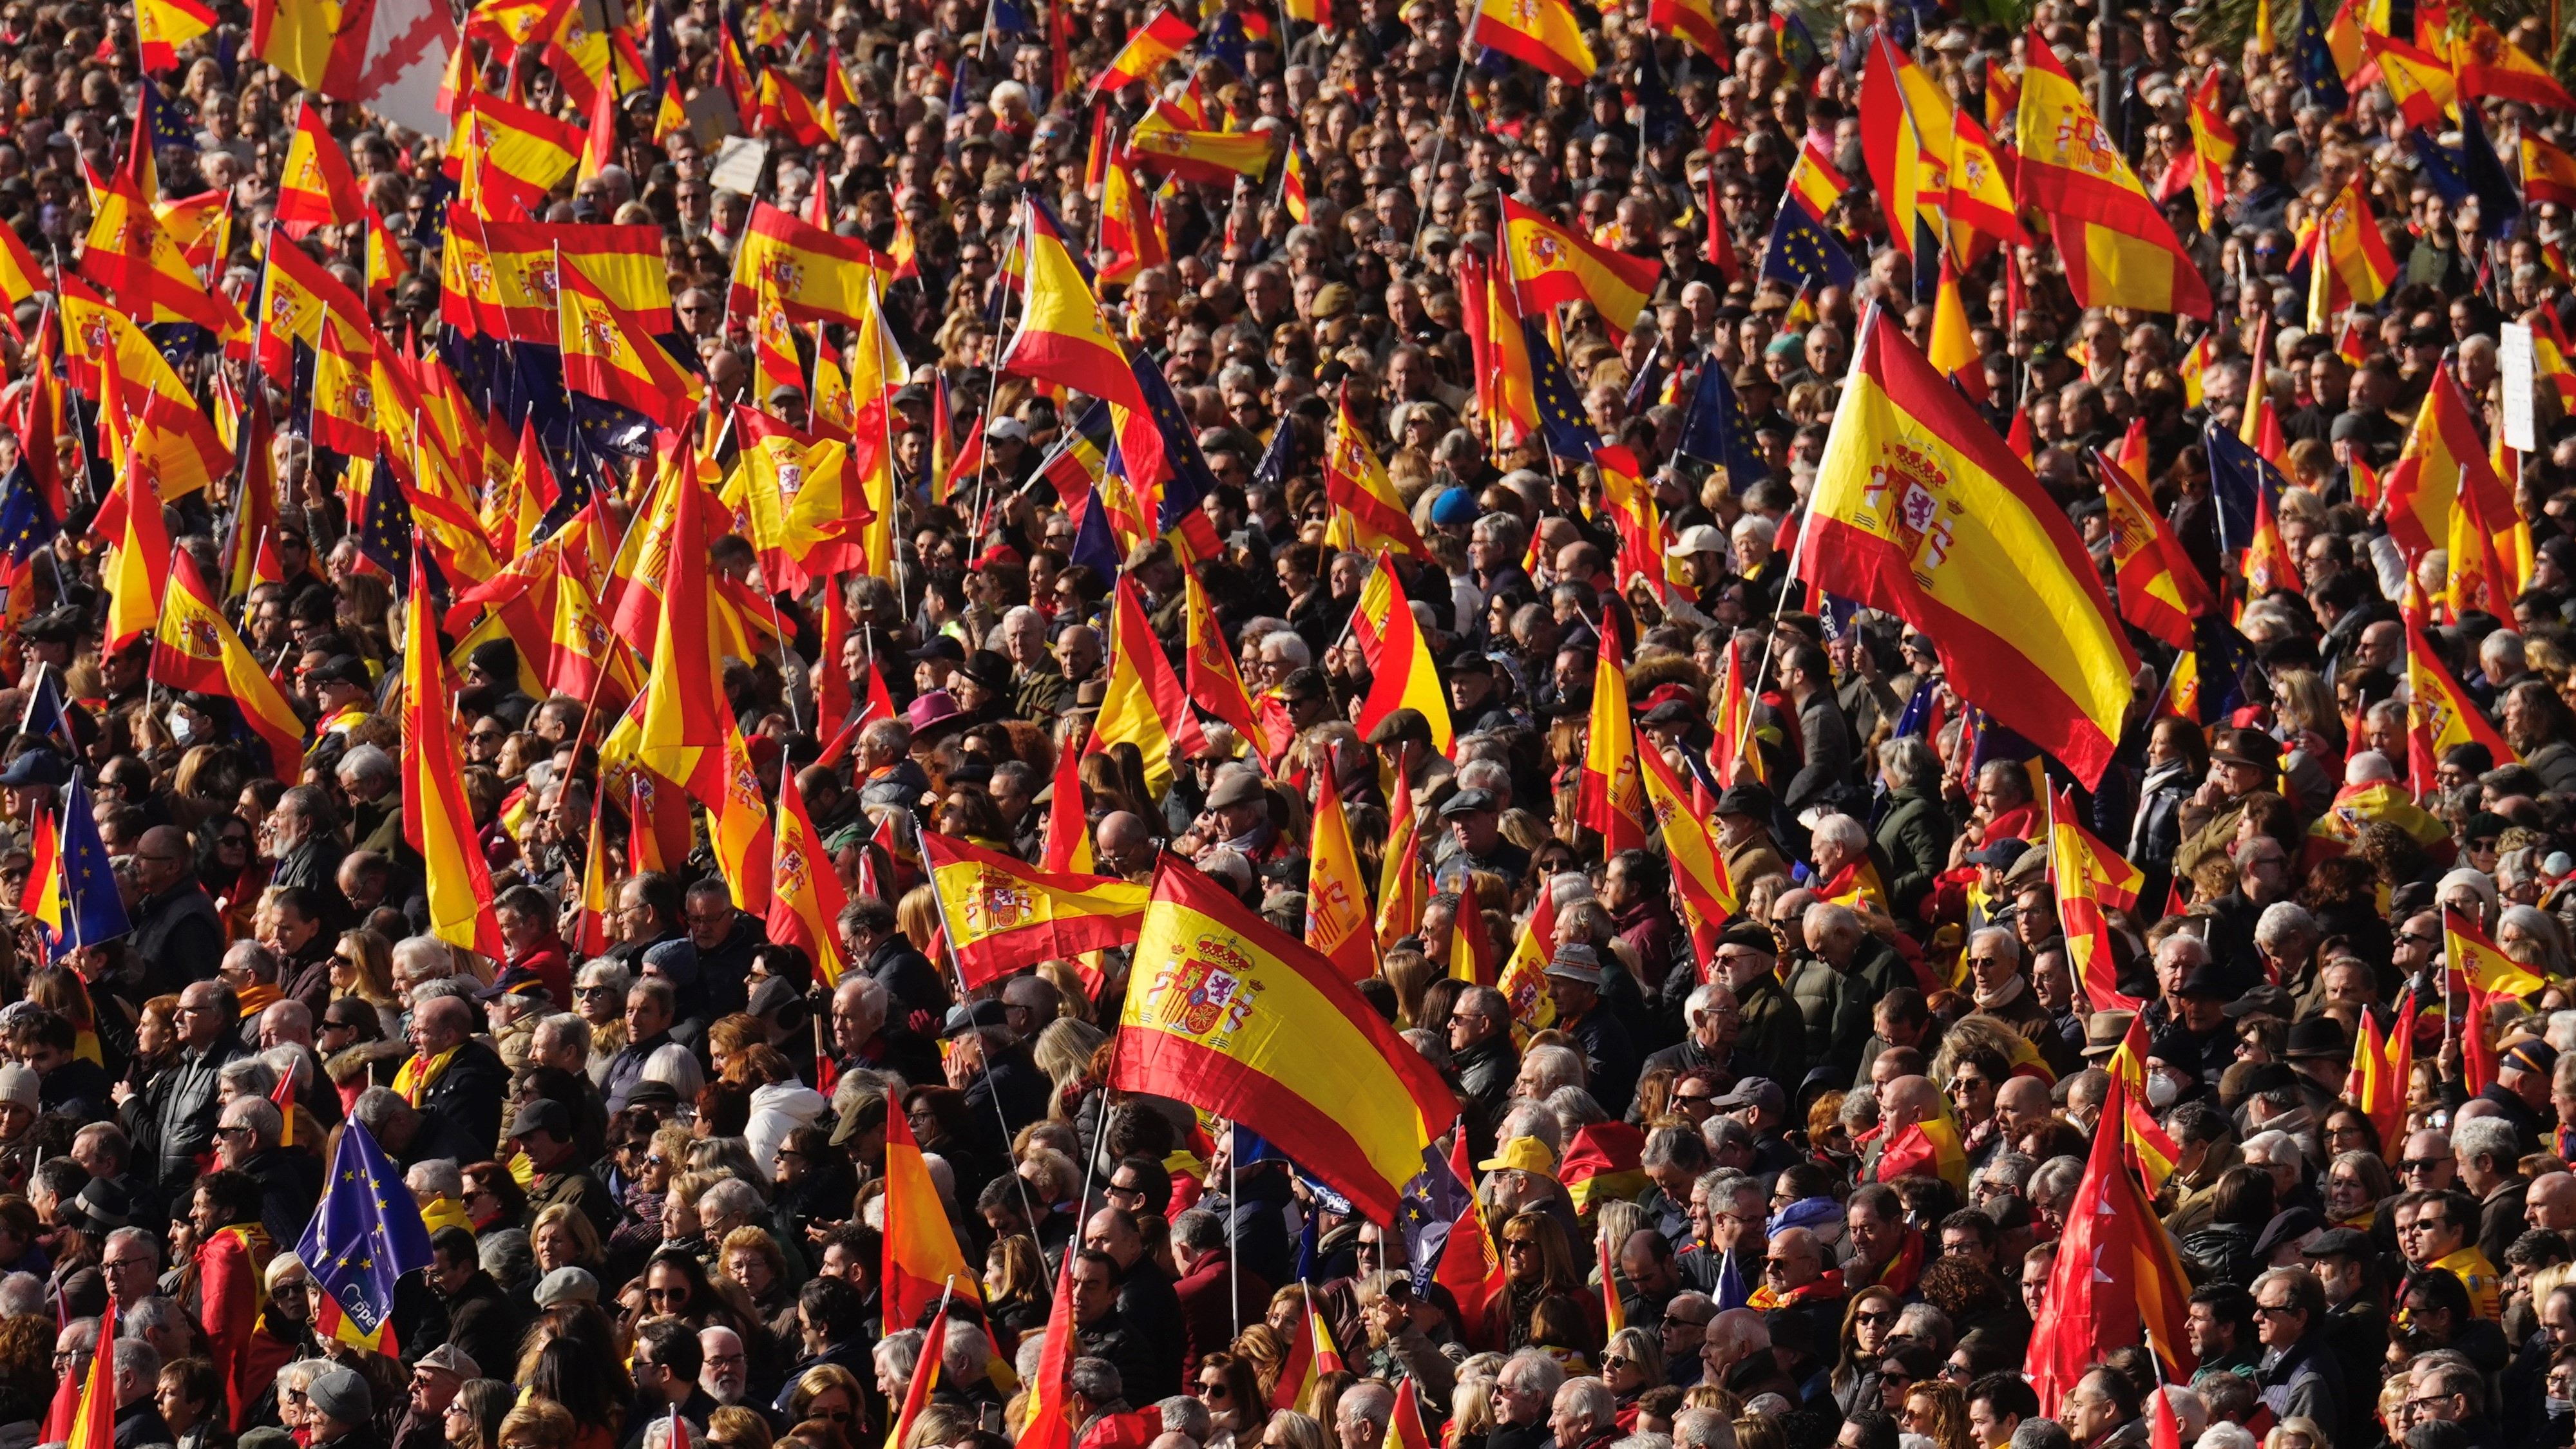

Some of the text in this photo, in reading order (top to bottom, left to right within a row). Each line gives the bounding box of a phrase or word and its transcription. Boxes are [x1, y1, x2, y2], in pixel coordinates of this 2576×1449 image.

[629, 442, 650, 455] ppe
[1821, 614, 1839, 639] ppe
[350, 1301, 377, 1327] ppe
